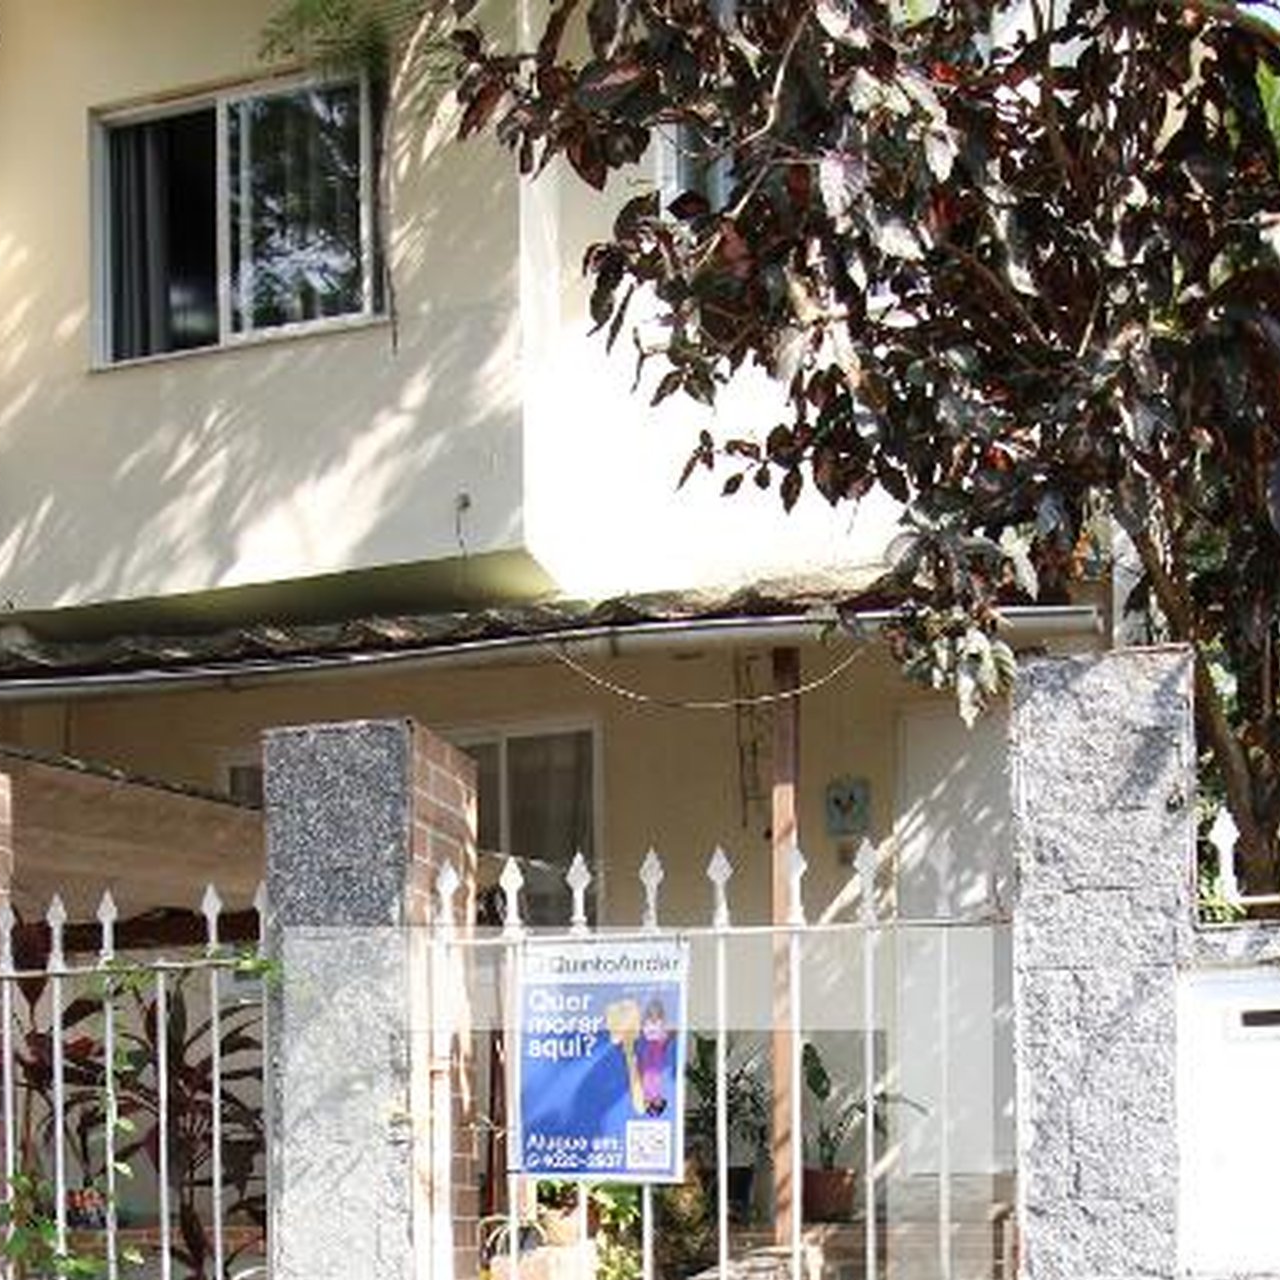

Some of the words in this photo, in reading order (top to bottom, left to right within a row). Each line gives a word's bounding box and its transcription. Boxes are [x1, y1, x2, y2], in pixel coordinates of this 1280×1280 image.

[549, 955, 680, 974] QuintoAndar
[528, 989, 591, 1012] Quer
[528, 1015, 604, 1034] morar
[528, 1034, 597, 1062] aqui?
